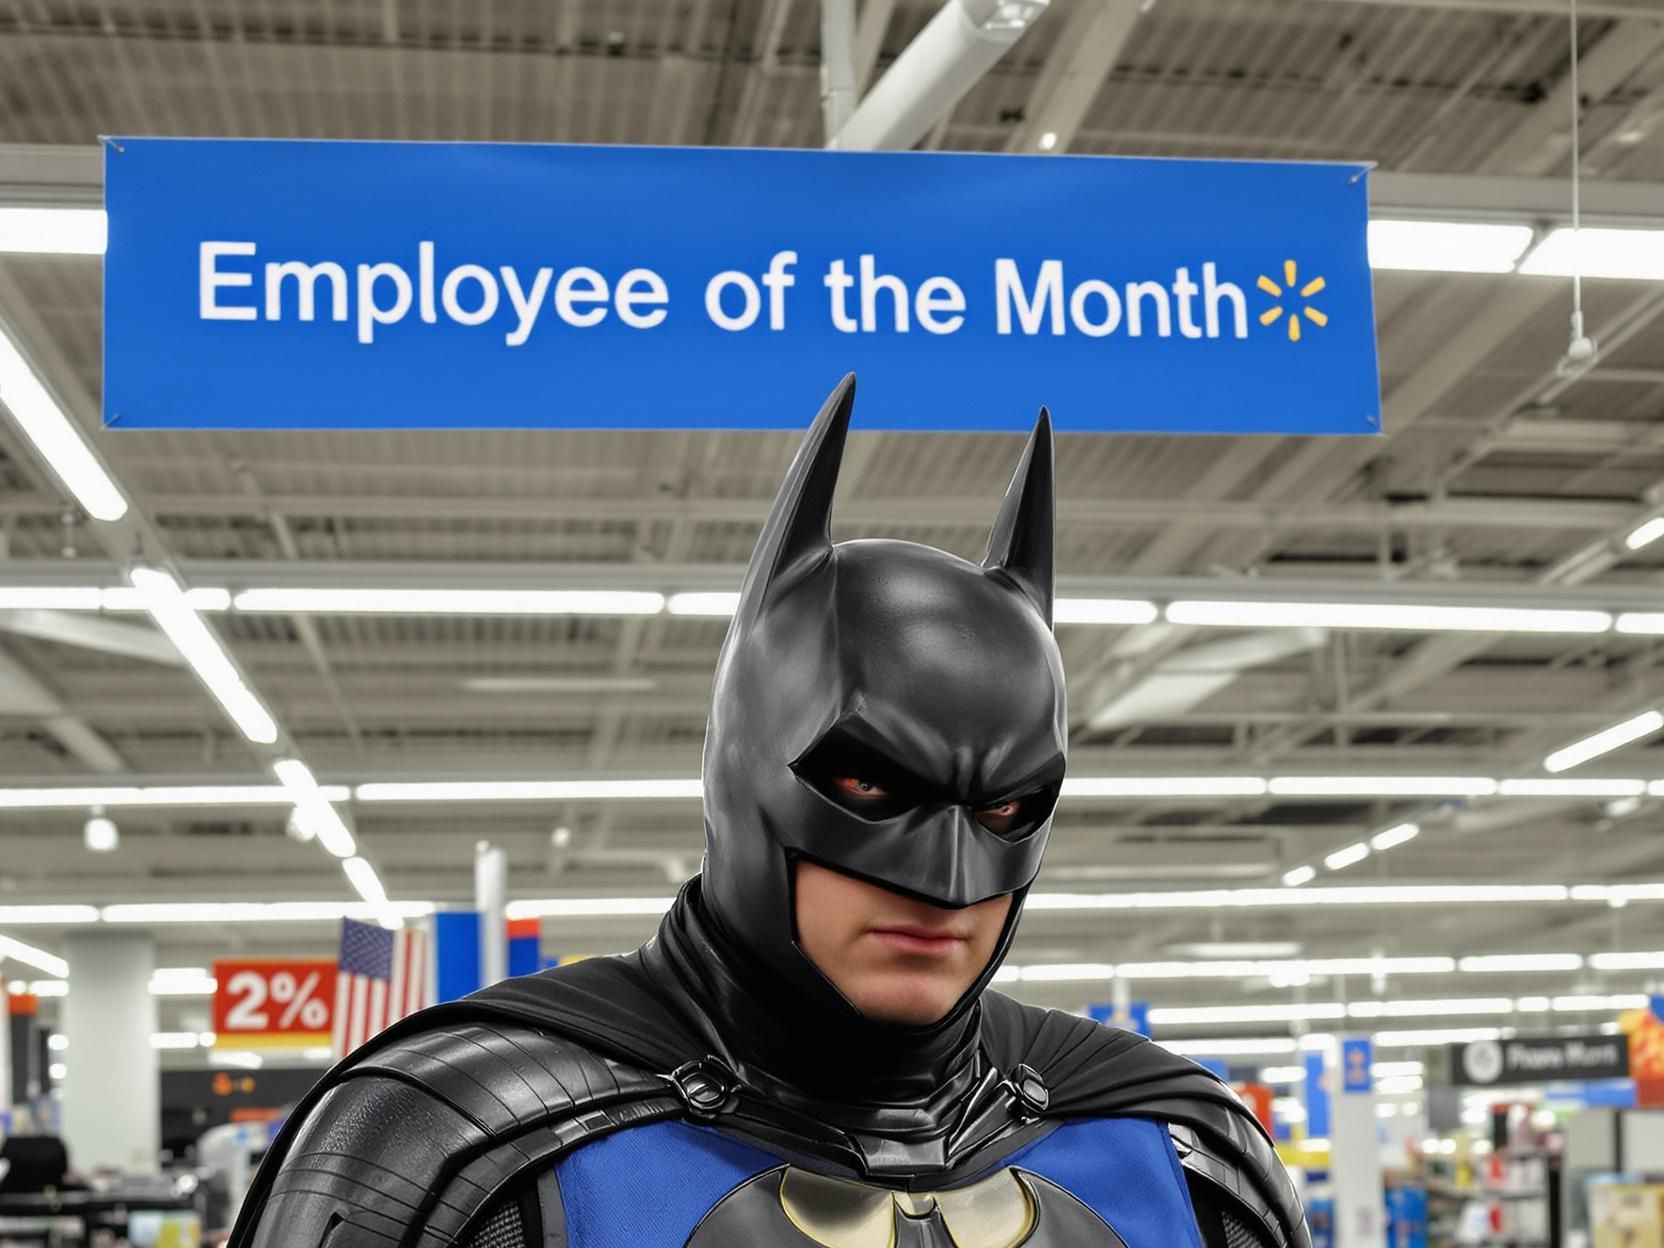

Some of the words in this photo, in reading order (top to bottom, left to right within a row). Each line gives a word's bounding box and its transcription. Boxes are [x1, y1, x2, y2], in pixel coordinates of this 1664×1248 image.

[199, 240, 670, 346] Employee
[705, 250, 798, 331] of
[823, 254, 966, 335] the
[995, 259, 1249, 340] Month
[225, 971, 328, 1030] 2%
